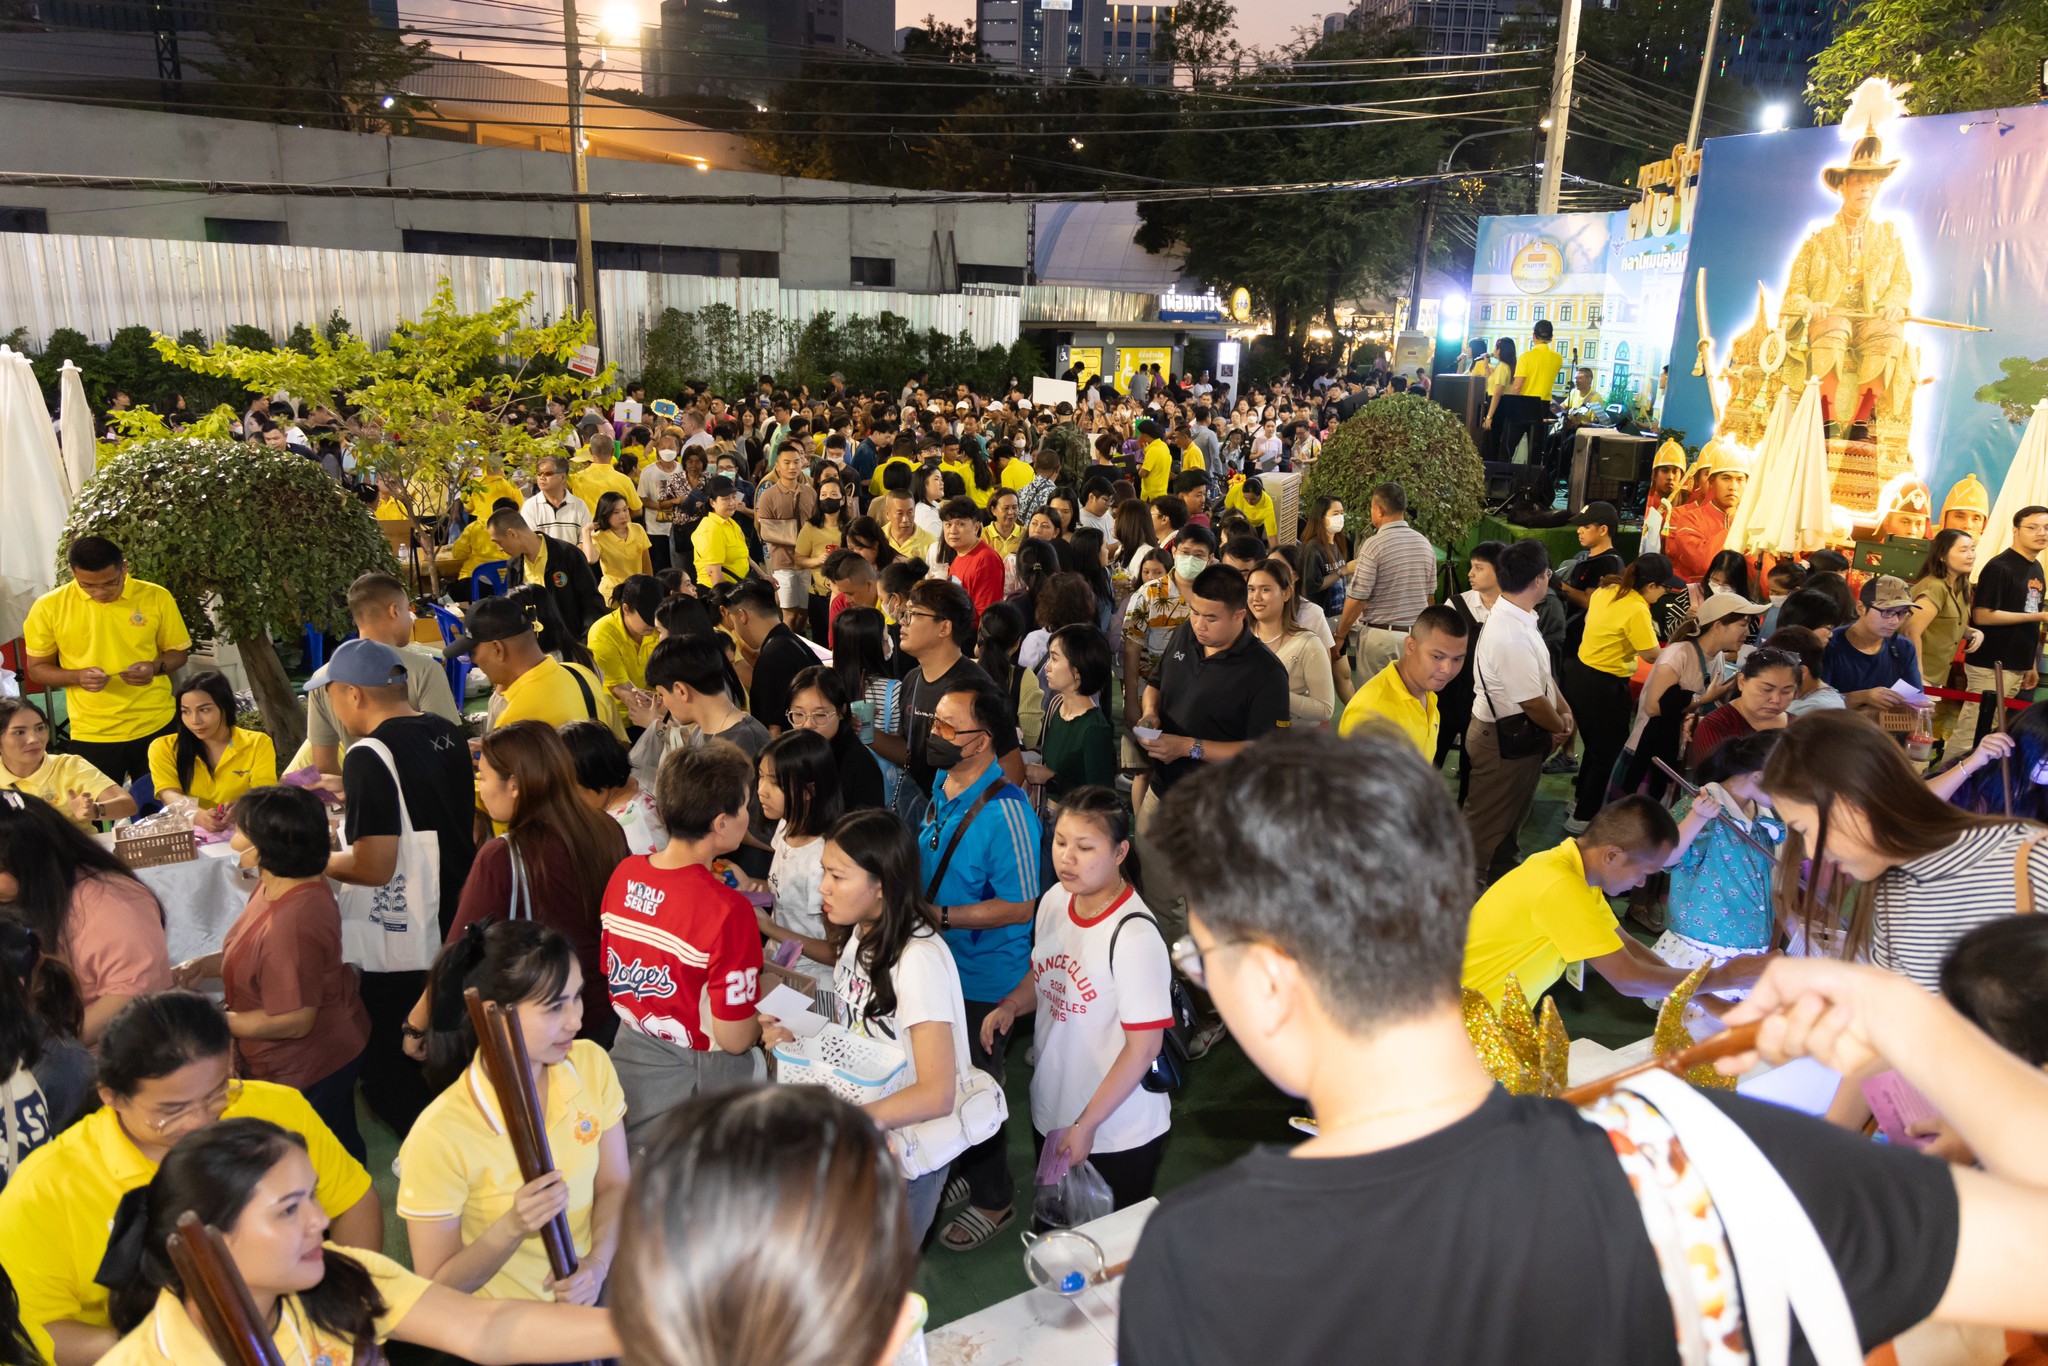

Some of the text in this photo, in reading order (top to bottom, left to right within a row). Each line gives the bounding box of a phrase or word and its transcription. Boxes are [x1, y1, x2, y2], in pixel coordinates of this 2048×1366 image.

[624, 894, 660, 916] SERIES
[626, 880, 665, 903] WORLD
[607, 947, 677, 1002] Dodgers
[725, 967, 759, 1005] 28
[1050, 979, 1066, 995] 2024
[1067, 960, 1097, 1002] CLUB
